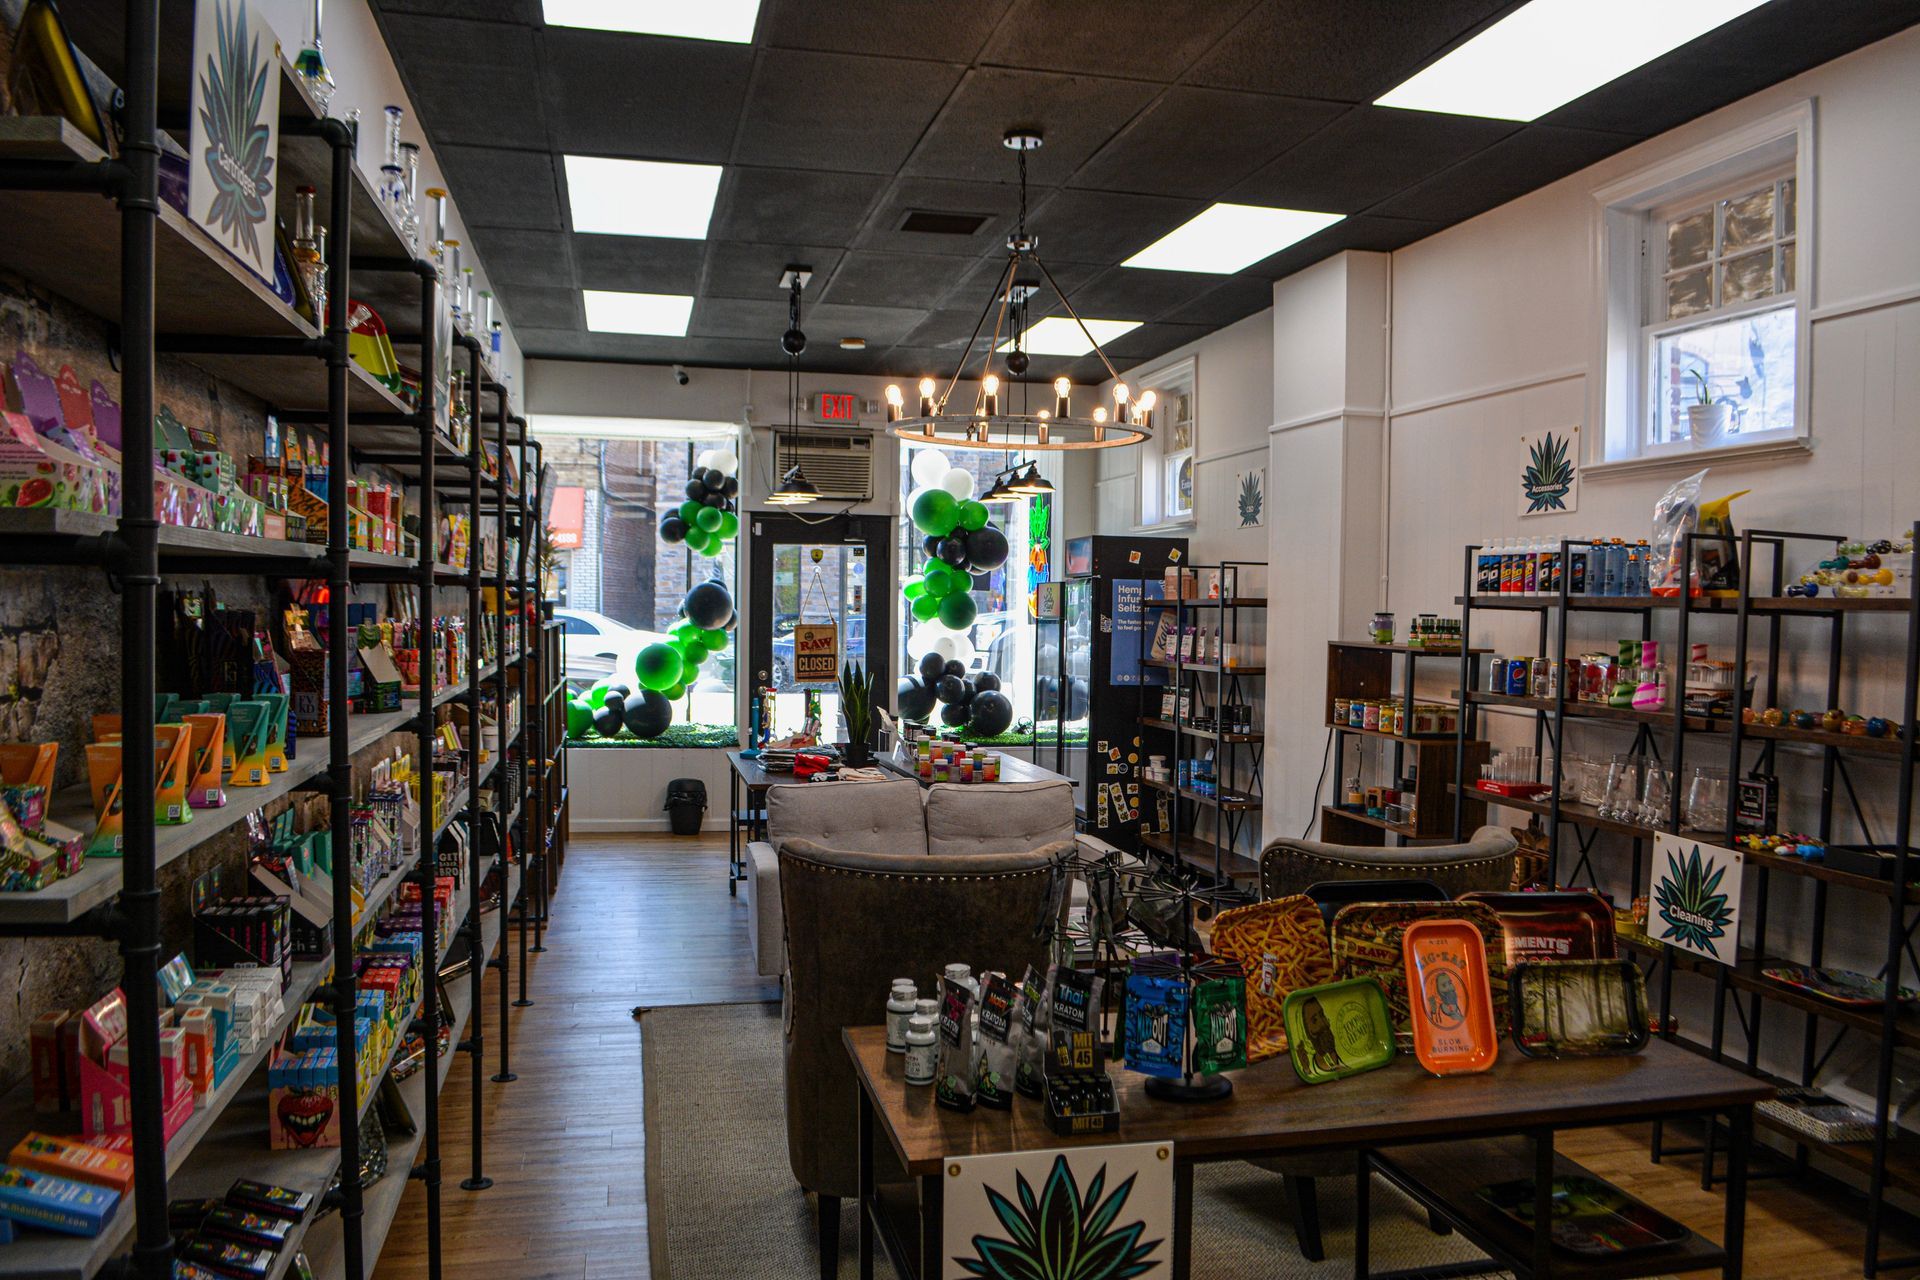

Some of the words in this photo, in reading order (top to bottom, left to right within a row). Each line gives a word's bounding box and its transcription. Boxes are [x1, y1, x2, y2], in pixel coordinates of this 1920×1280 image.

[218, 142, 256, 198] Cartridges
[821, 393, 855, 419] EXIT
[1531, 482, 1563, 493] Accessories
[1118, 604, 1150, 612] Seltzr
[800, 637, 833, 651] RAW
[799, 657, 834, 671] CLOSED
[1670, 904, 1714, 933] Cleaning
[1356, 946, 1391, 962] RAW
[1059, 983, 1085, 1005] Thai
[1054, 1002, 1085, 1020] KRATOM
[981, 1009, 1006, 1029] KRATOM
[1072, 1033, 1094, 1048] MIT
[1432, 1045, 1470, 1053] BURNING
[1076, 1053, 1091, 1066] 45
[1072, 1116, 1092, 1130] MIT
